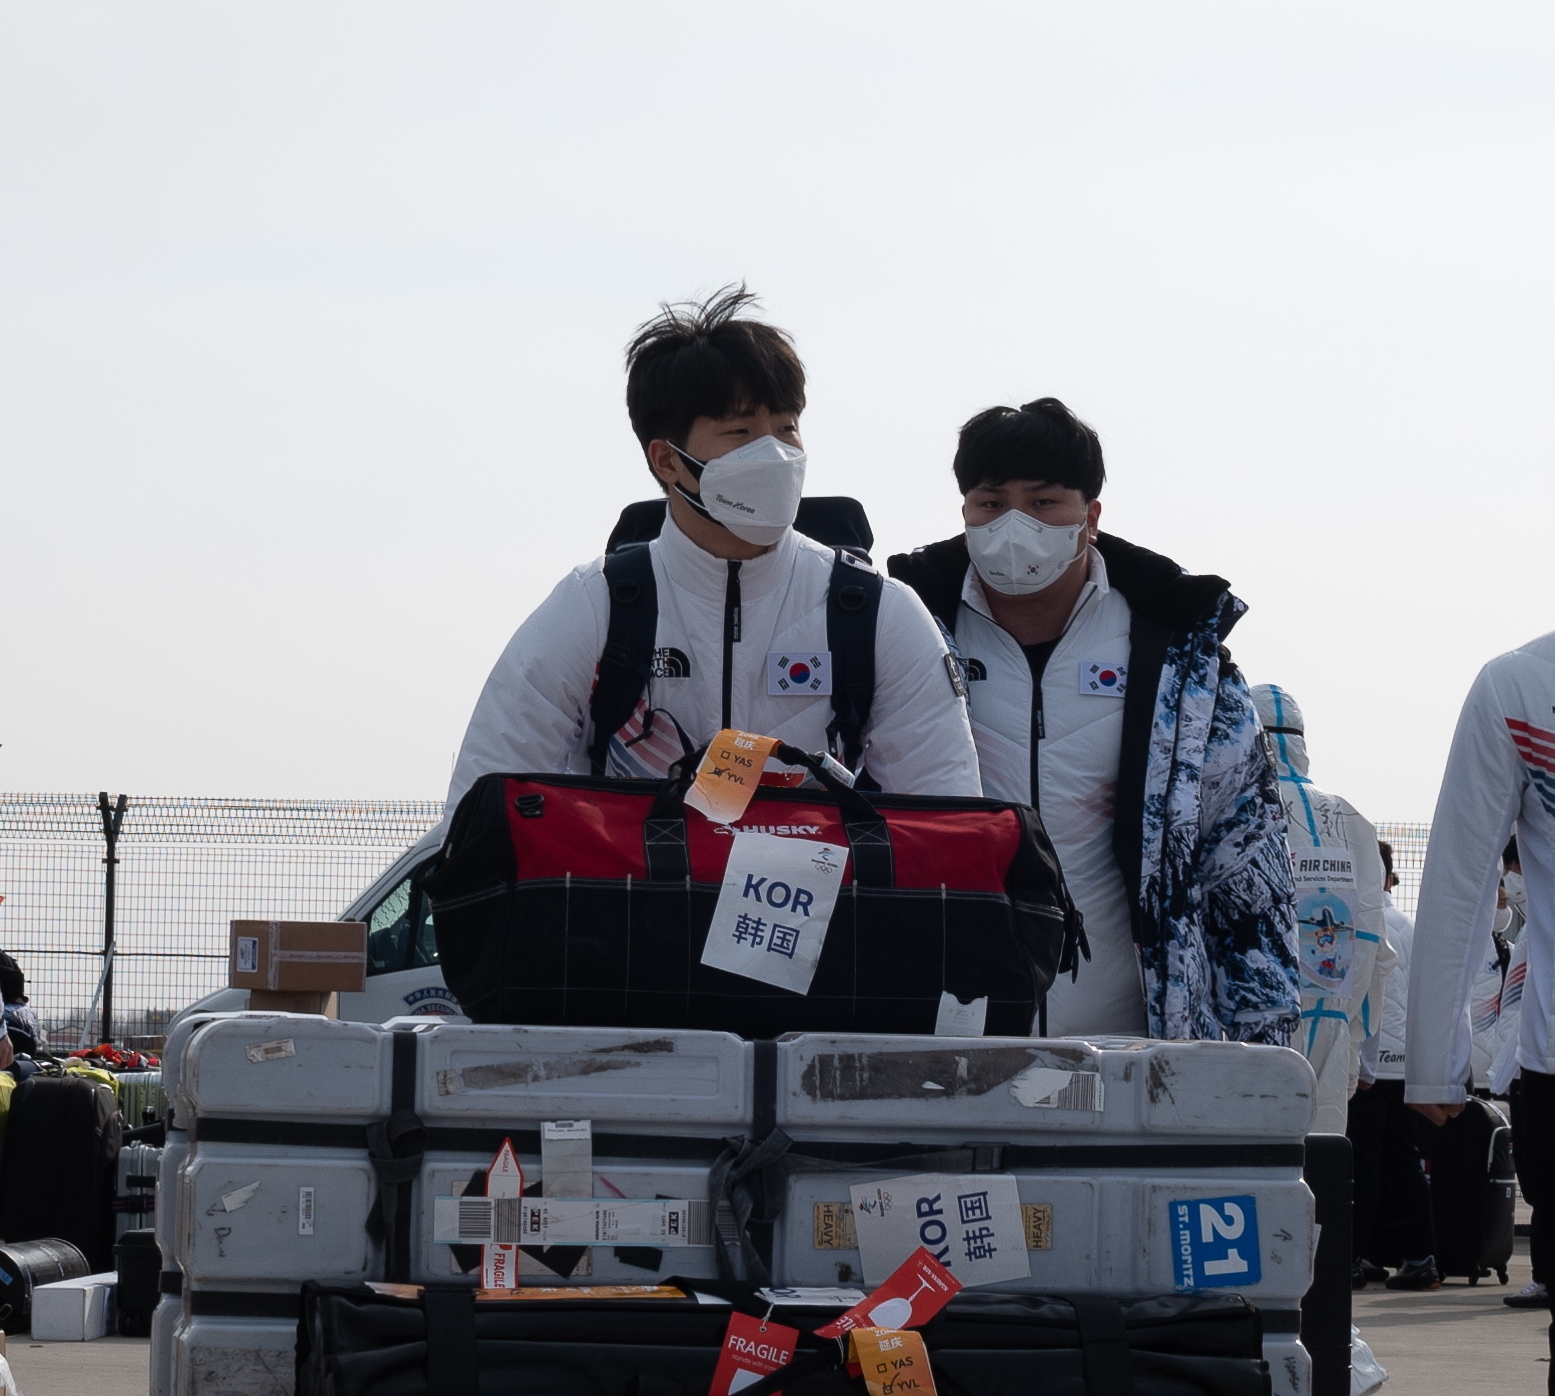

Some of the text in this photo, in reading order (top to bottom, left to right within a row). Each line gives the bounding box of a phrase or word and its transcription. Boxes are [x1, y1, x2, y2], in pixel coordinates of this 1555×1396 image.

[653, 647, 669, 657] HE
[650, 668, 670, 678] ACE
[733, 753, 753, 768] YAS
[726, 772, 746, 787] YVL
[742, 824, 821, 836] HUSKY
[1300, 859, 1352, 874] AIR CHINA
[742, 872, 815, 918] KOR
[731, 913, 801, 960] 韩国
[1379, 1050, 1406, 1063] Team
[531, 1208, 541, 1233] PEK
[669, 1211, 678, 1236] PEK
[823, 1204, 834, 1246] HEAVY
[956, 1191, 998, 1262] 韩国
[1033, 1207, 1044, 1248] HEAVY
[1199, 1202, 1249, 1276] 21
[727, 1334, 790, 1365] FRAGILE
[890, 1356, 914, 1369] YAS
[897, 1380, 920, 1392] YVL
